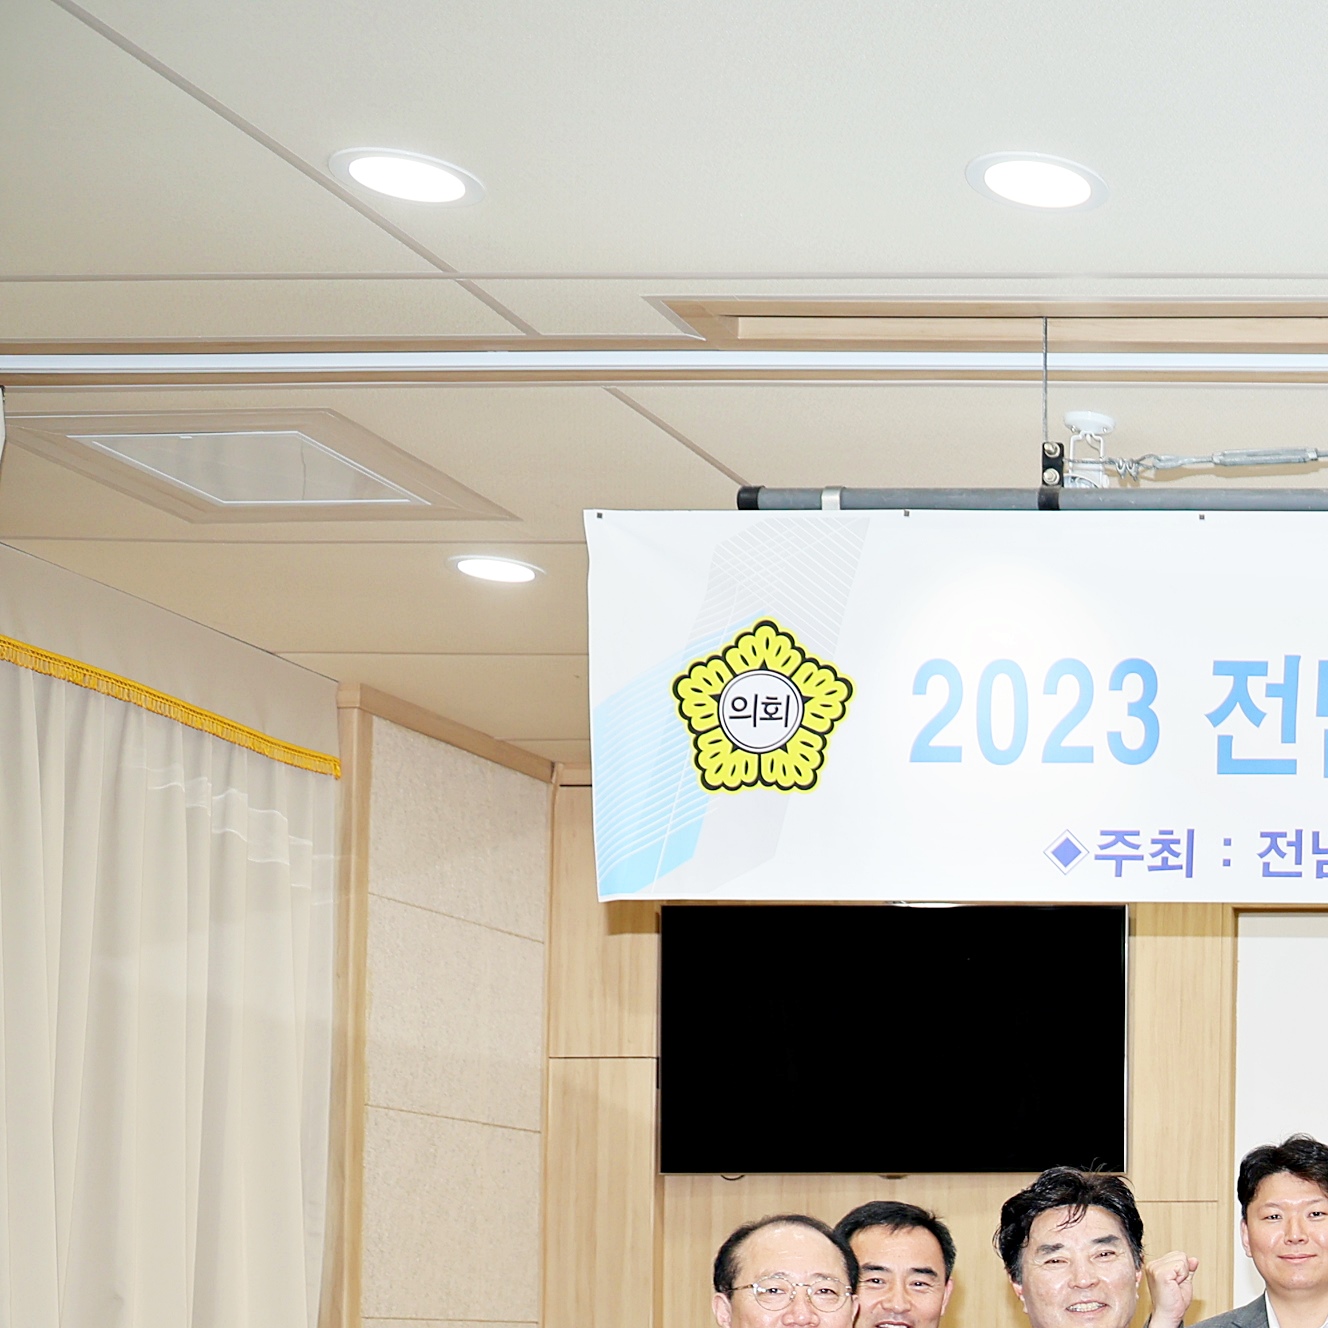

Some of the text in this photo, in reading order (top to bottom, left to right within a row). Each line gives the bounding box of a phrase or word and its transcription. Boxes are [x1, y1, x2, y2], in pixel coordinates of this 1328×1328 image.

[728, 693, 791, 728] 의회
[908, 656, 1163, 766] 2023
[1093, 828, 1196, 879] 주최
